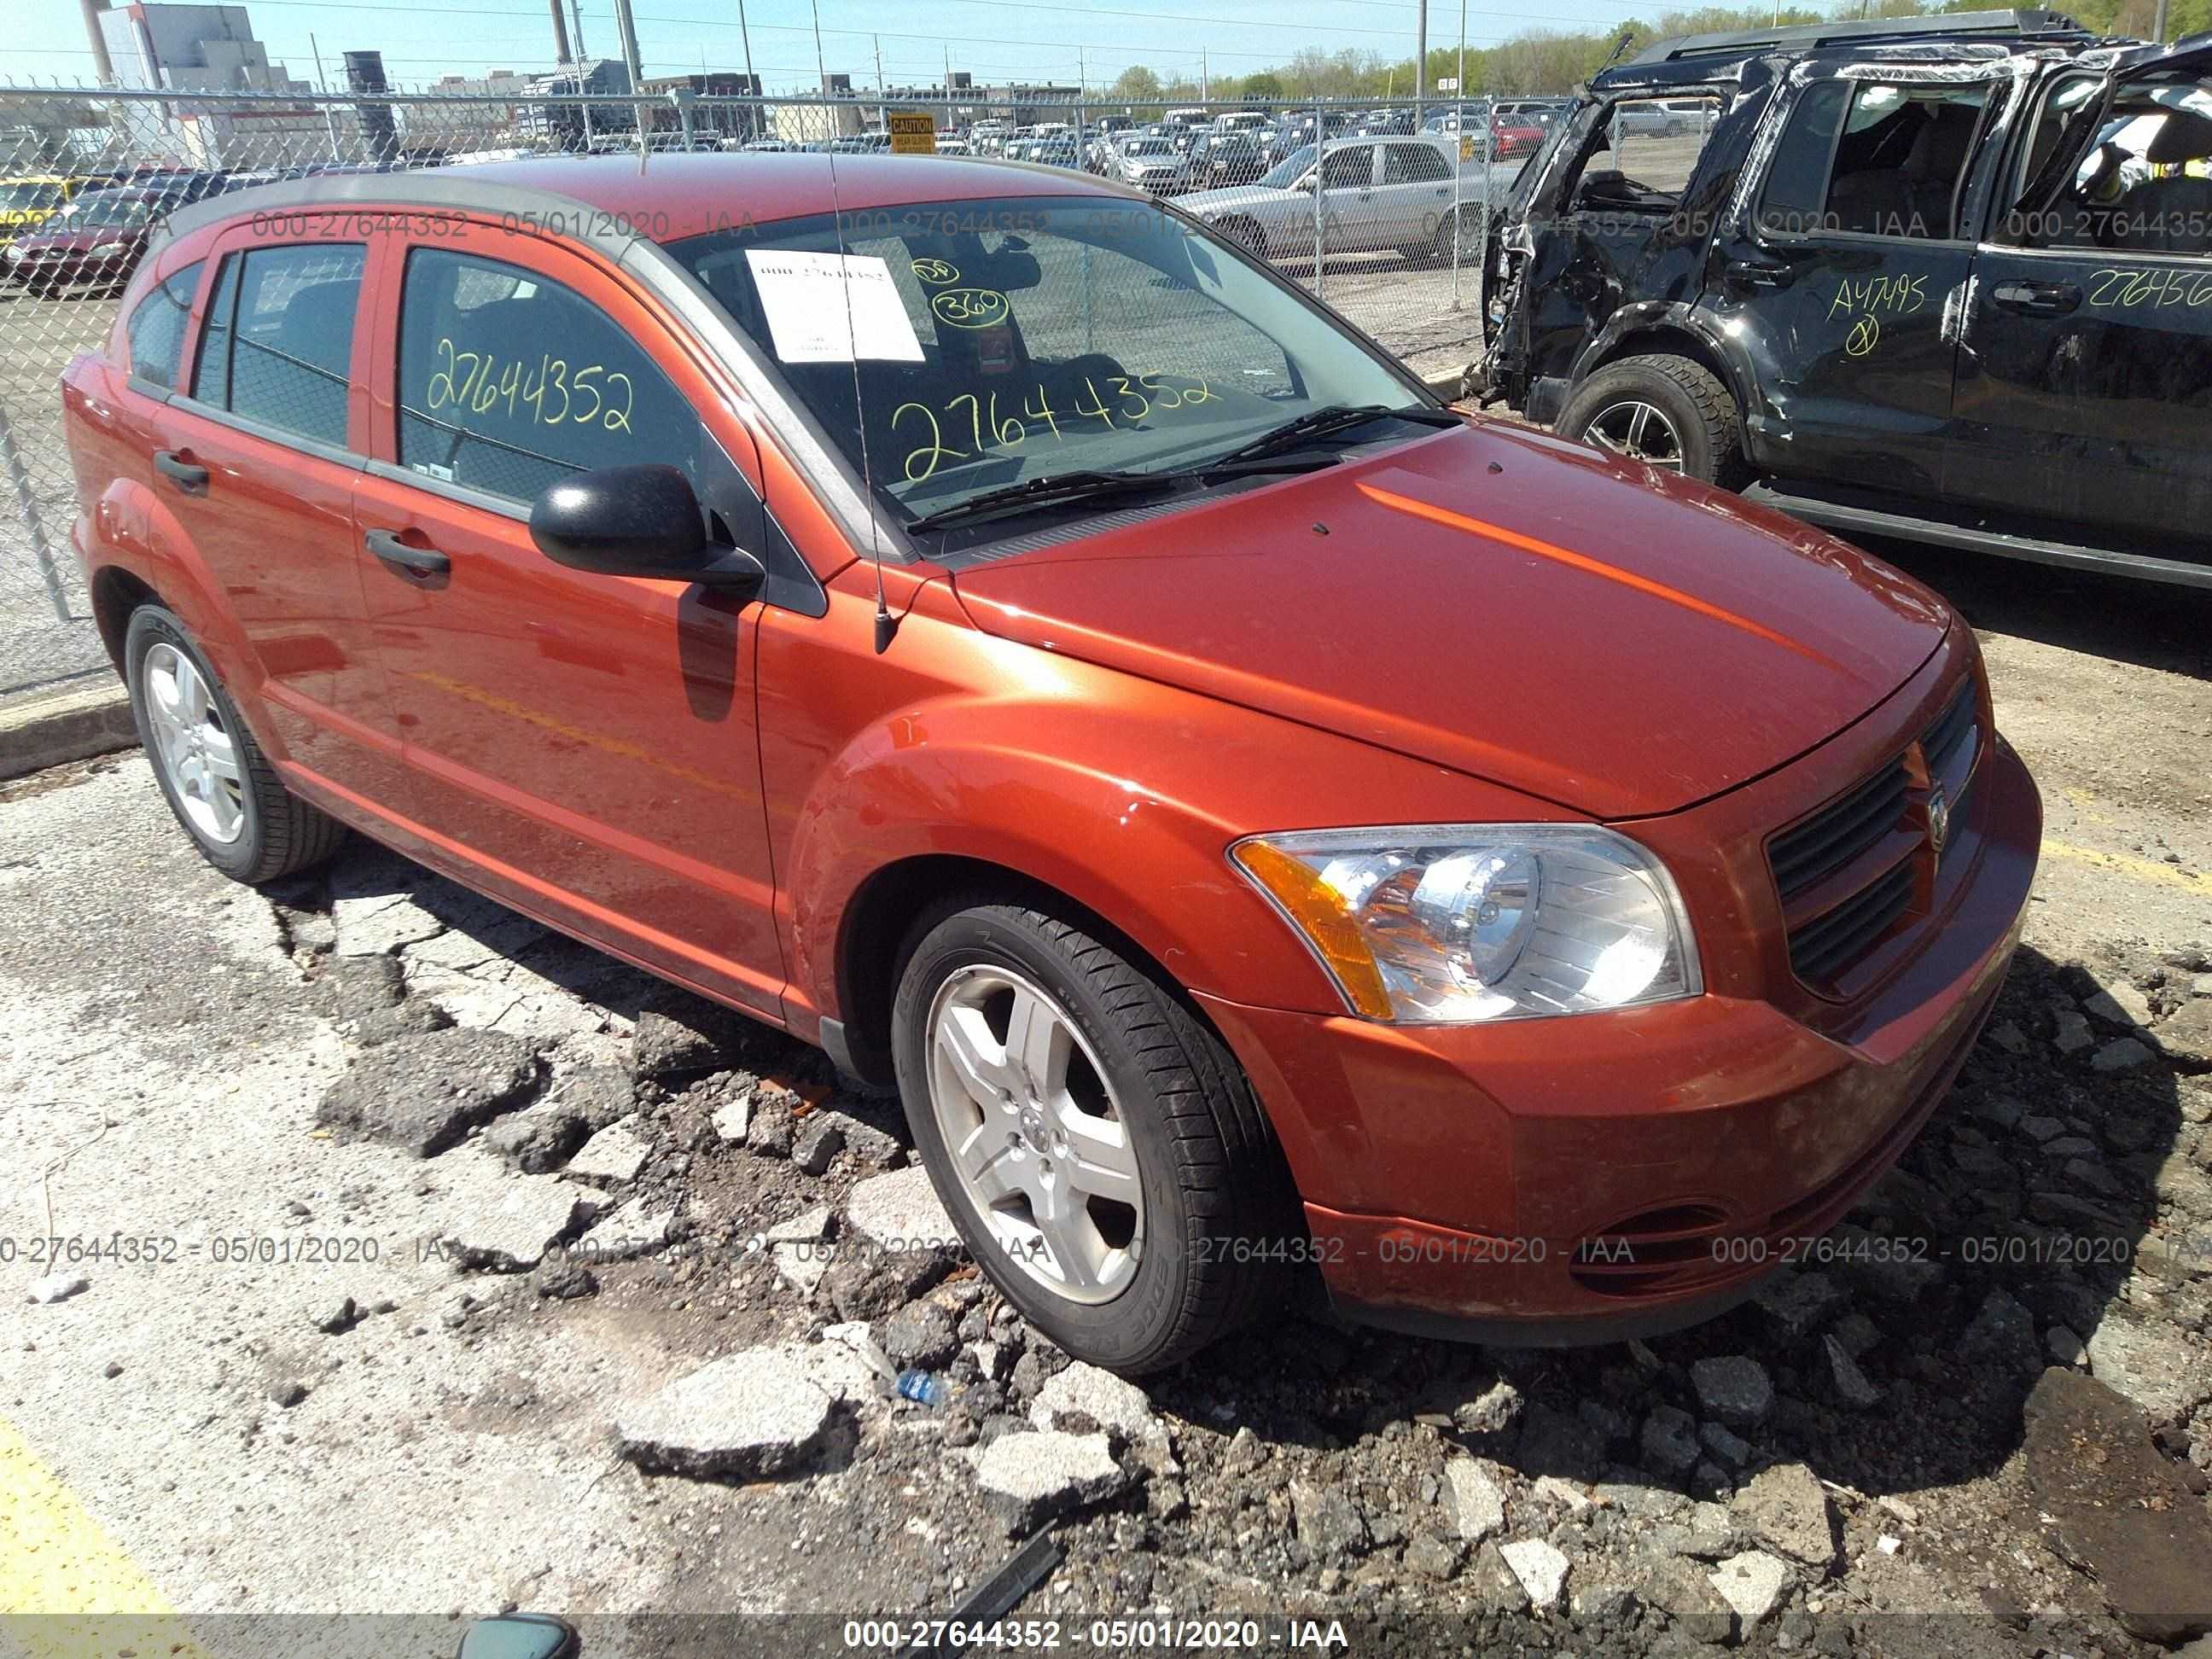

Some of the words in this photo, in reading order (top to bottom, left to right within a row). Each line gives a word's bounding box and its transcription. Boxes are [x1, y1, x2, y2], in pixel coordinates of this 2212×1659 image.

[893, 119, 933, 133] CAUTION
[935, 291, 999, 319] 360
[428, 339, 632, 435] 27644352
[892, 370, 1224, 482] 27644352
